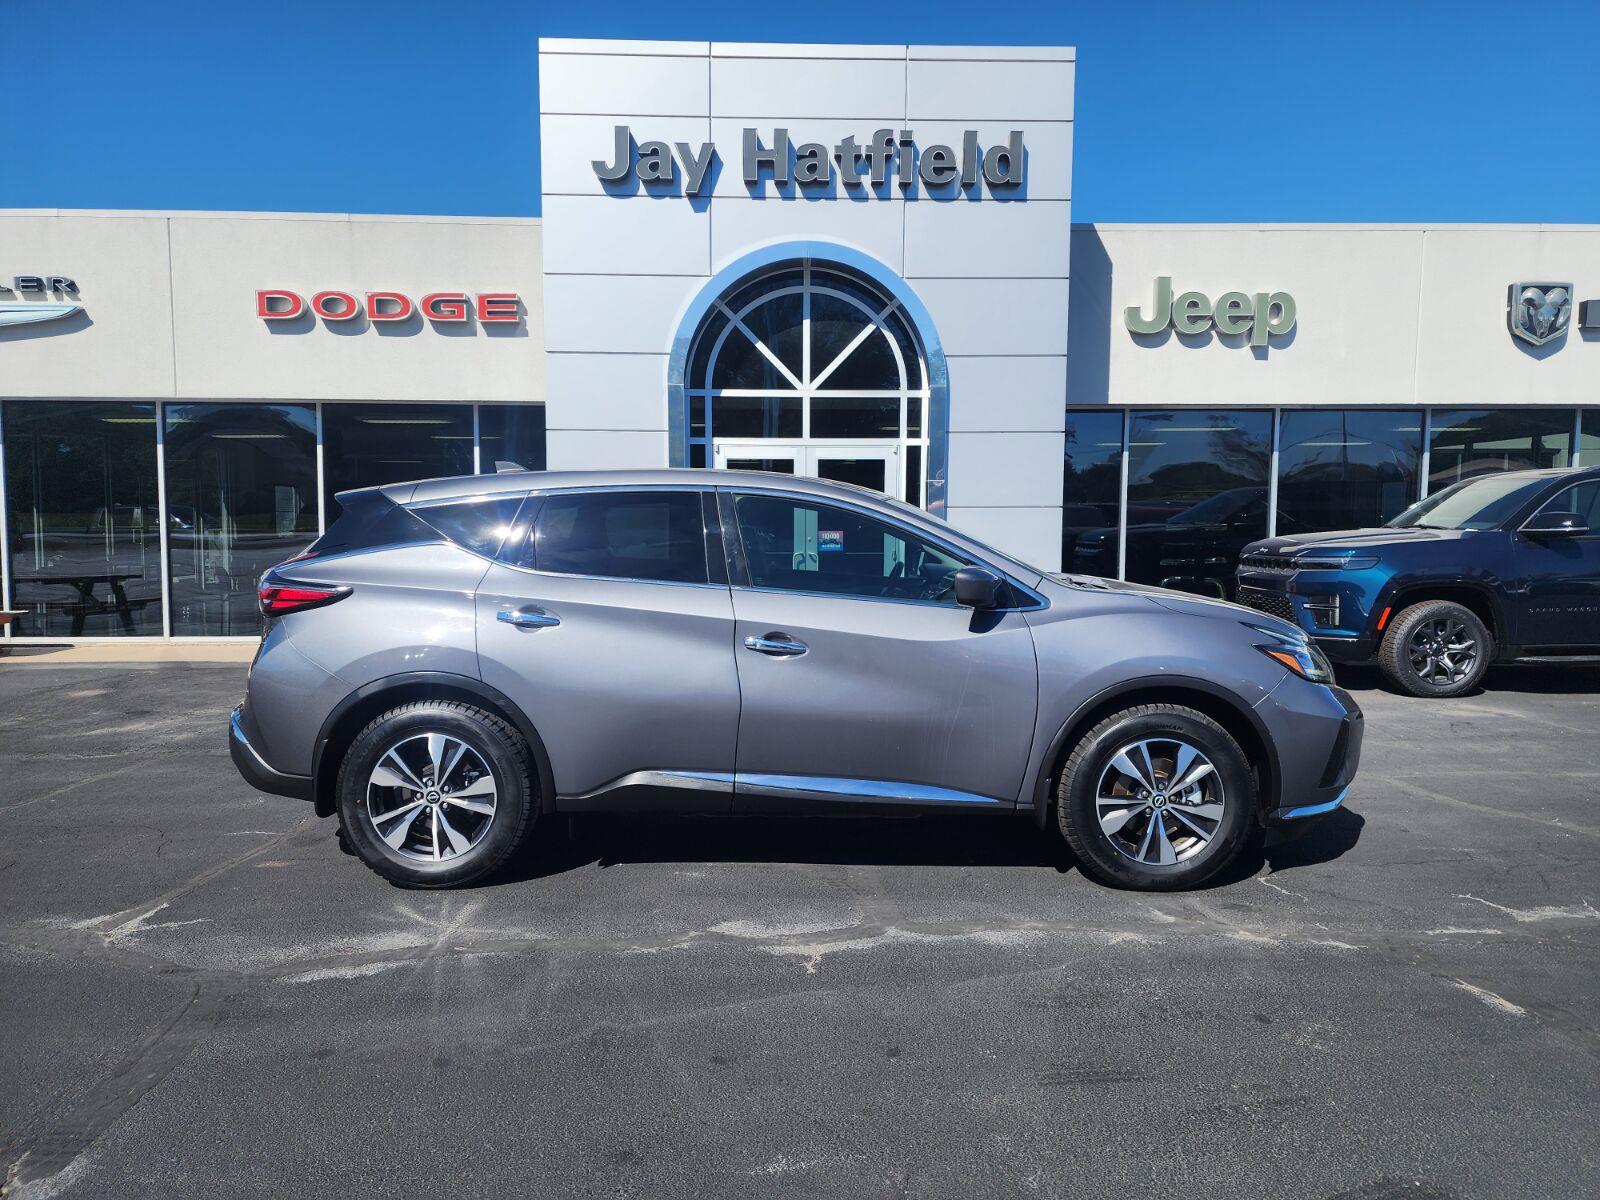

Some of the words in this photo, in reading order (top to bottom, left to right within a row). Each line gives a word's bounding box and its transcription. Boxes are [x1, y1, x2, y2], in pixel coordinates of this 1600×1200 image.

[591, 125, 716, 195] Jay
[743, 127, 1026, 188] Hatfield
[255, 289, 520, 322] DODGE
[1124, 276, 1297, 347] Jeep
